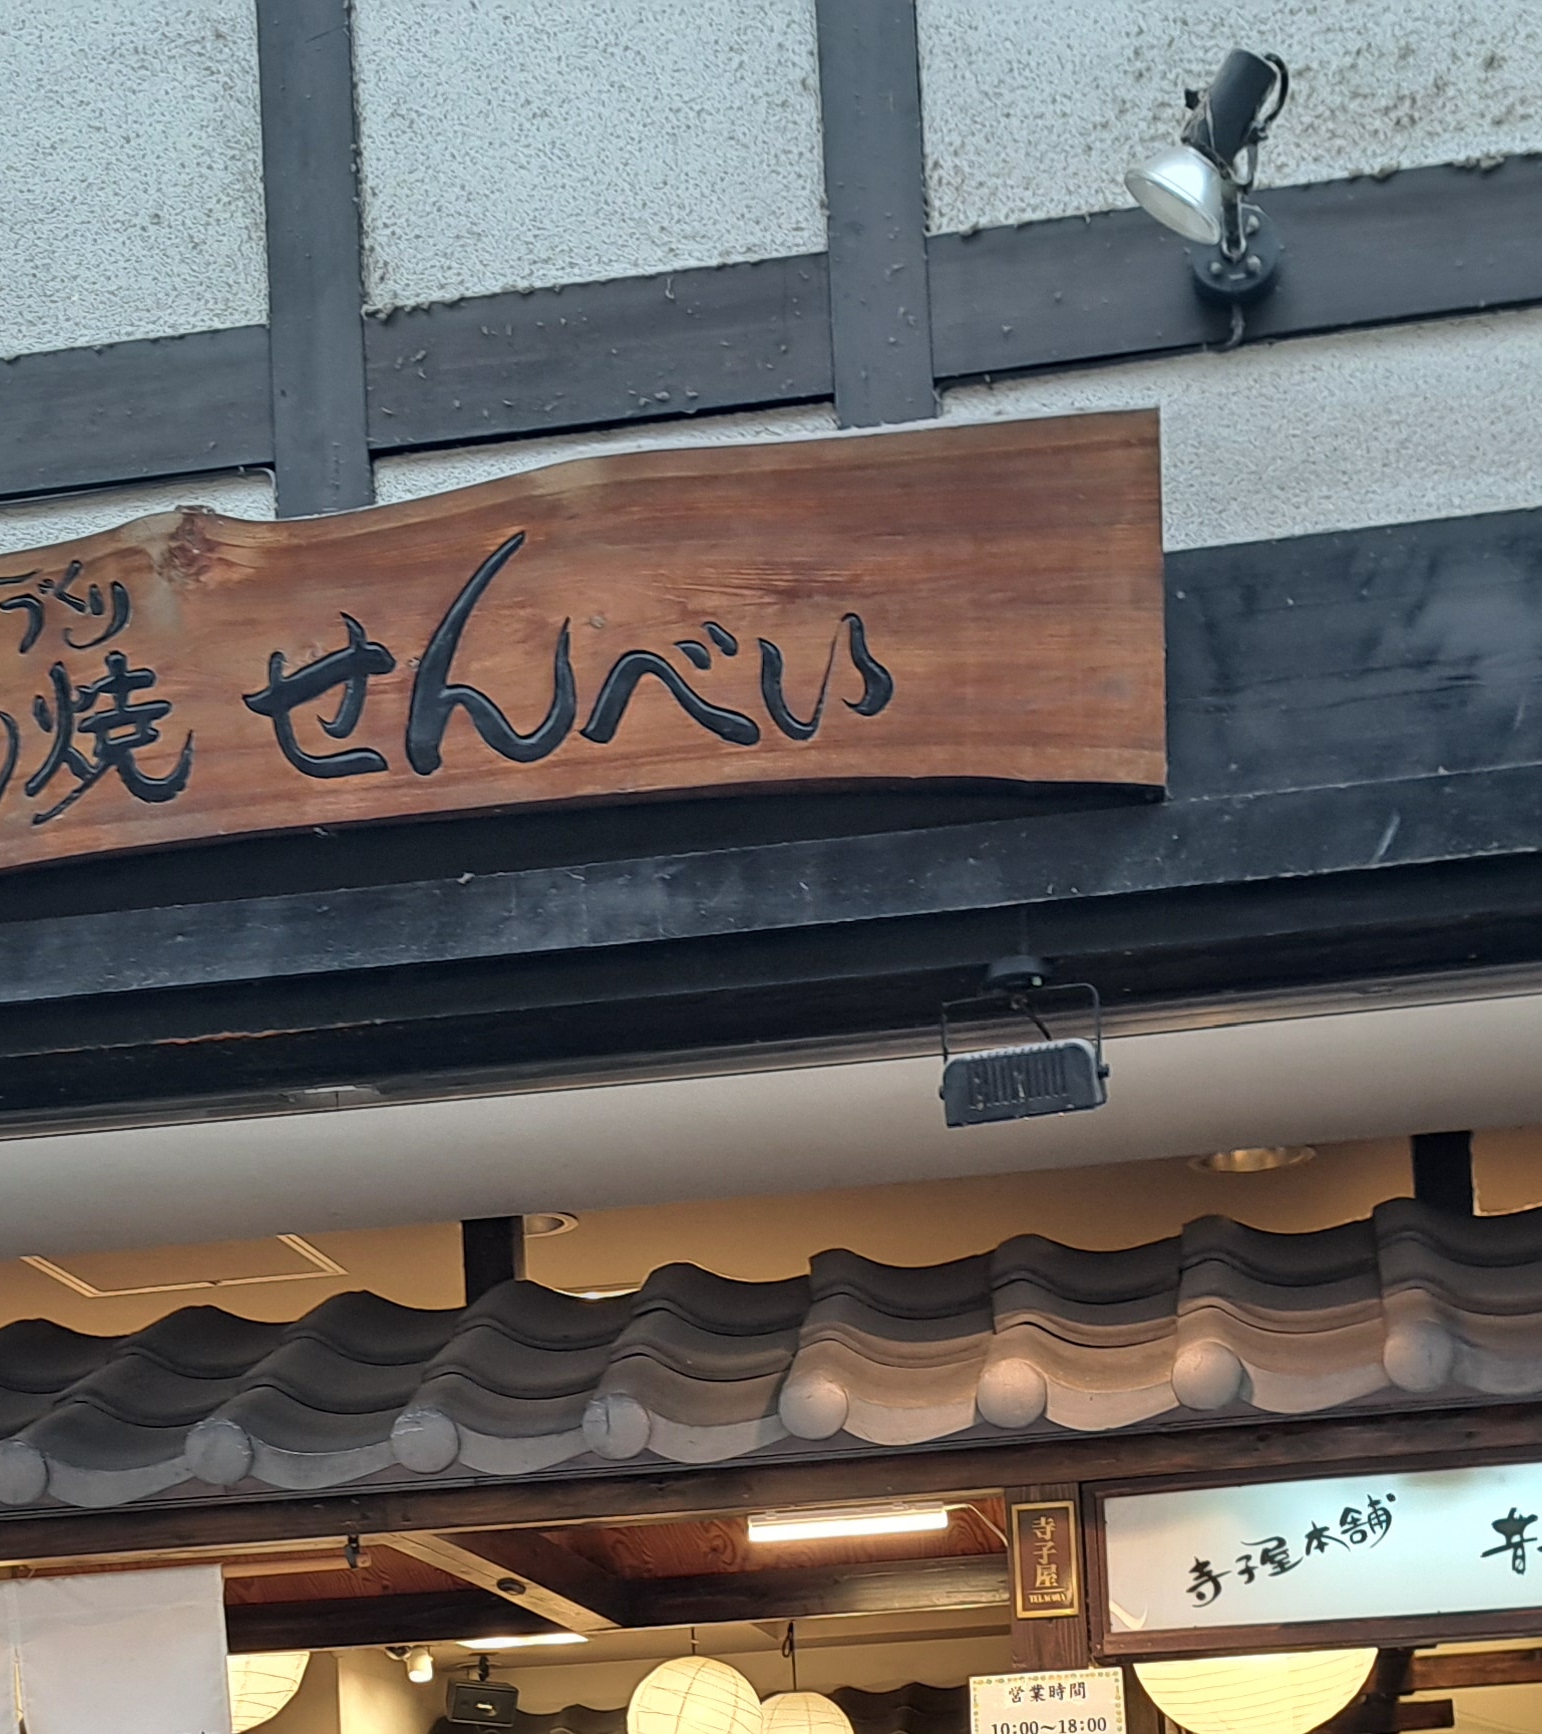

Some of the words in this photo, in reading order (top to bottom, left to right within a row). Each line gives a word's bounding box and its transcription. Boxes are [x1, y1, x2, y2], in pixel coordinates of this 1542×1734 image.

[242, 529, 893, 776] せんべい
[1031, 1517, 1058, 1587] 寺子屋
[1183, 1492, 1399, 1608] 寺子屋本舗
[1009, 1682, 1087, 1703] 営業時間
